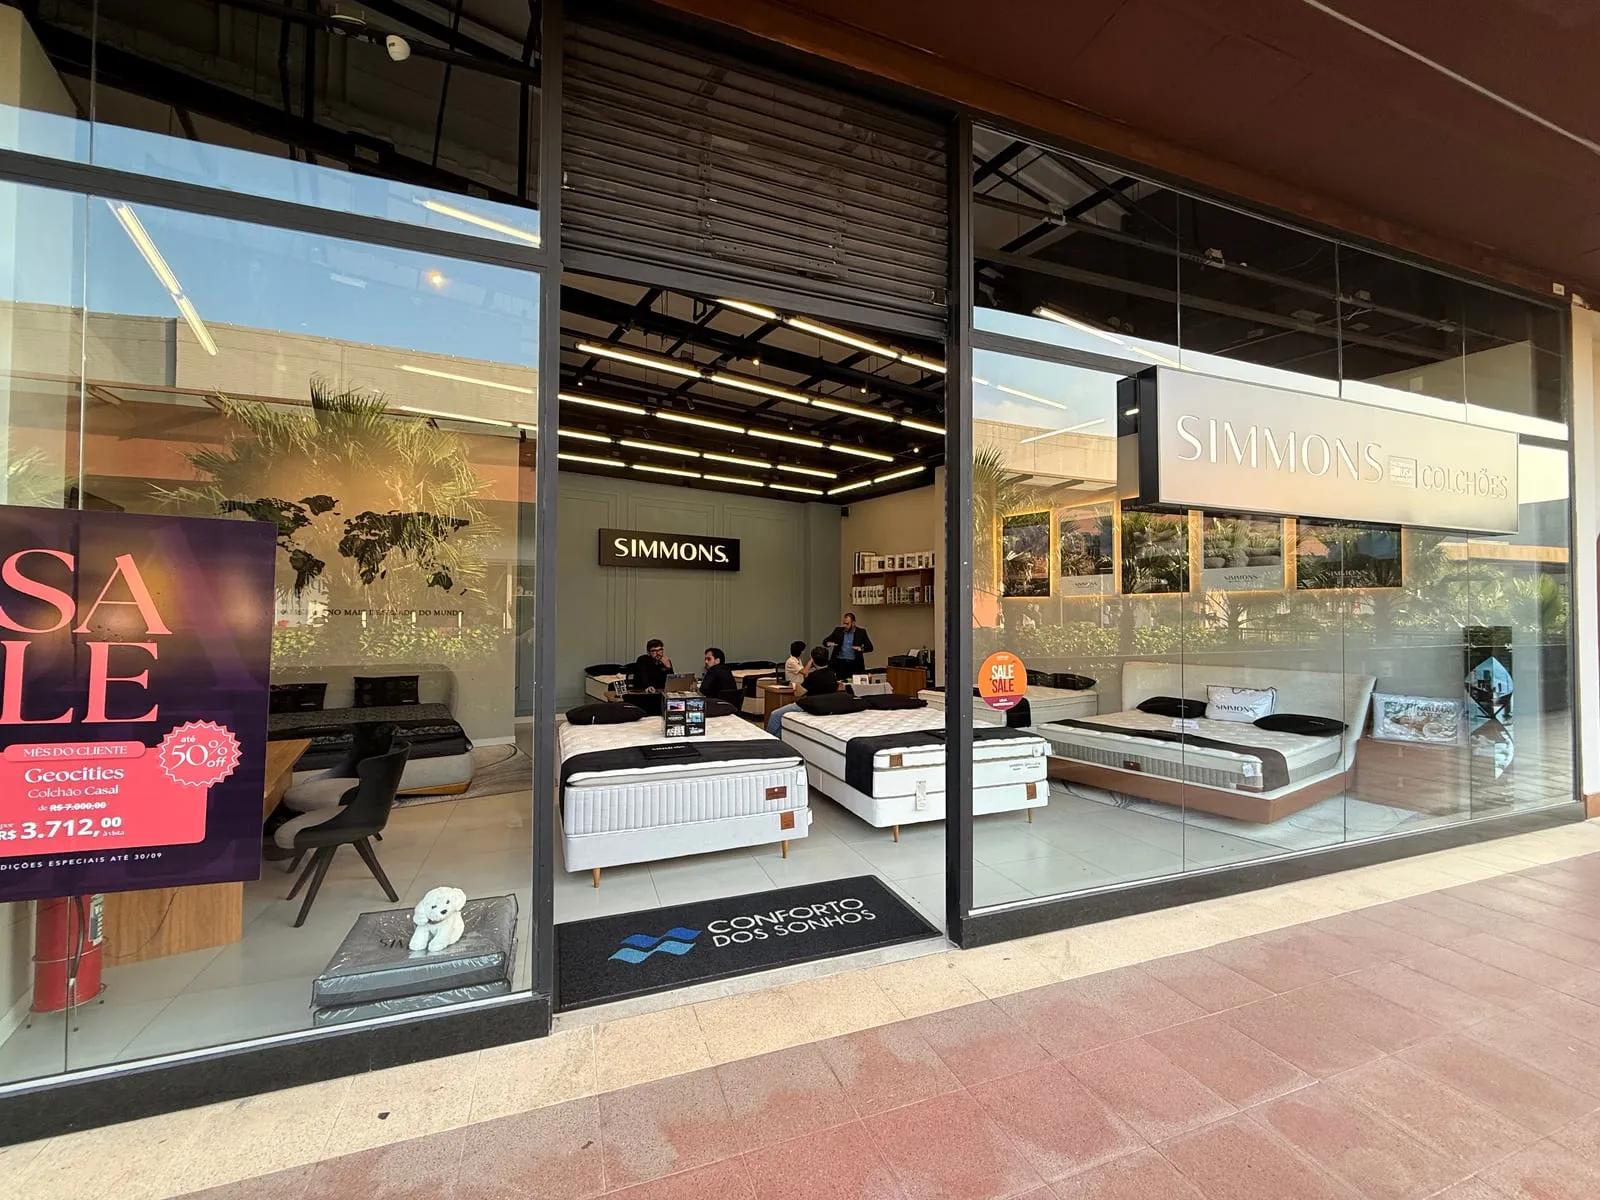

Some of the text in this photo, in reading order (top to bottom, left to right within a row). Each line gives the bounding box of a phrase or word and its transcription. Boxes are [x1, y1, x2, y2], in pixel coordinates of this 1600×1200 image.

[1176, 414, 1384, 484] SIMMONS
[1422, 464, 1508, 500] COLCHÕES
[991, 664, 1015, 680] SALE
[991, 679, 1015, 693] SALE
[180, 735, 197, 743] até
[23, 745, 128, 757] MÊS DO CLIENTE
[170, 740, 228, 770] 50%
[206, 756, 227, 768] off
[24, 766, 125, 783] Geocities
[27, 784, 119, 798] Colchão Casal
[48, 856, 105, 867] ESPECIAIS
[110, 854, 129, 862] ATÉ
[134, 852, 162, 861] 30/09
[707, 898, 864, 933] CONFORTO
[713, 908, 877, 948] DOS SONHOS
